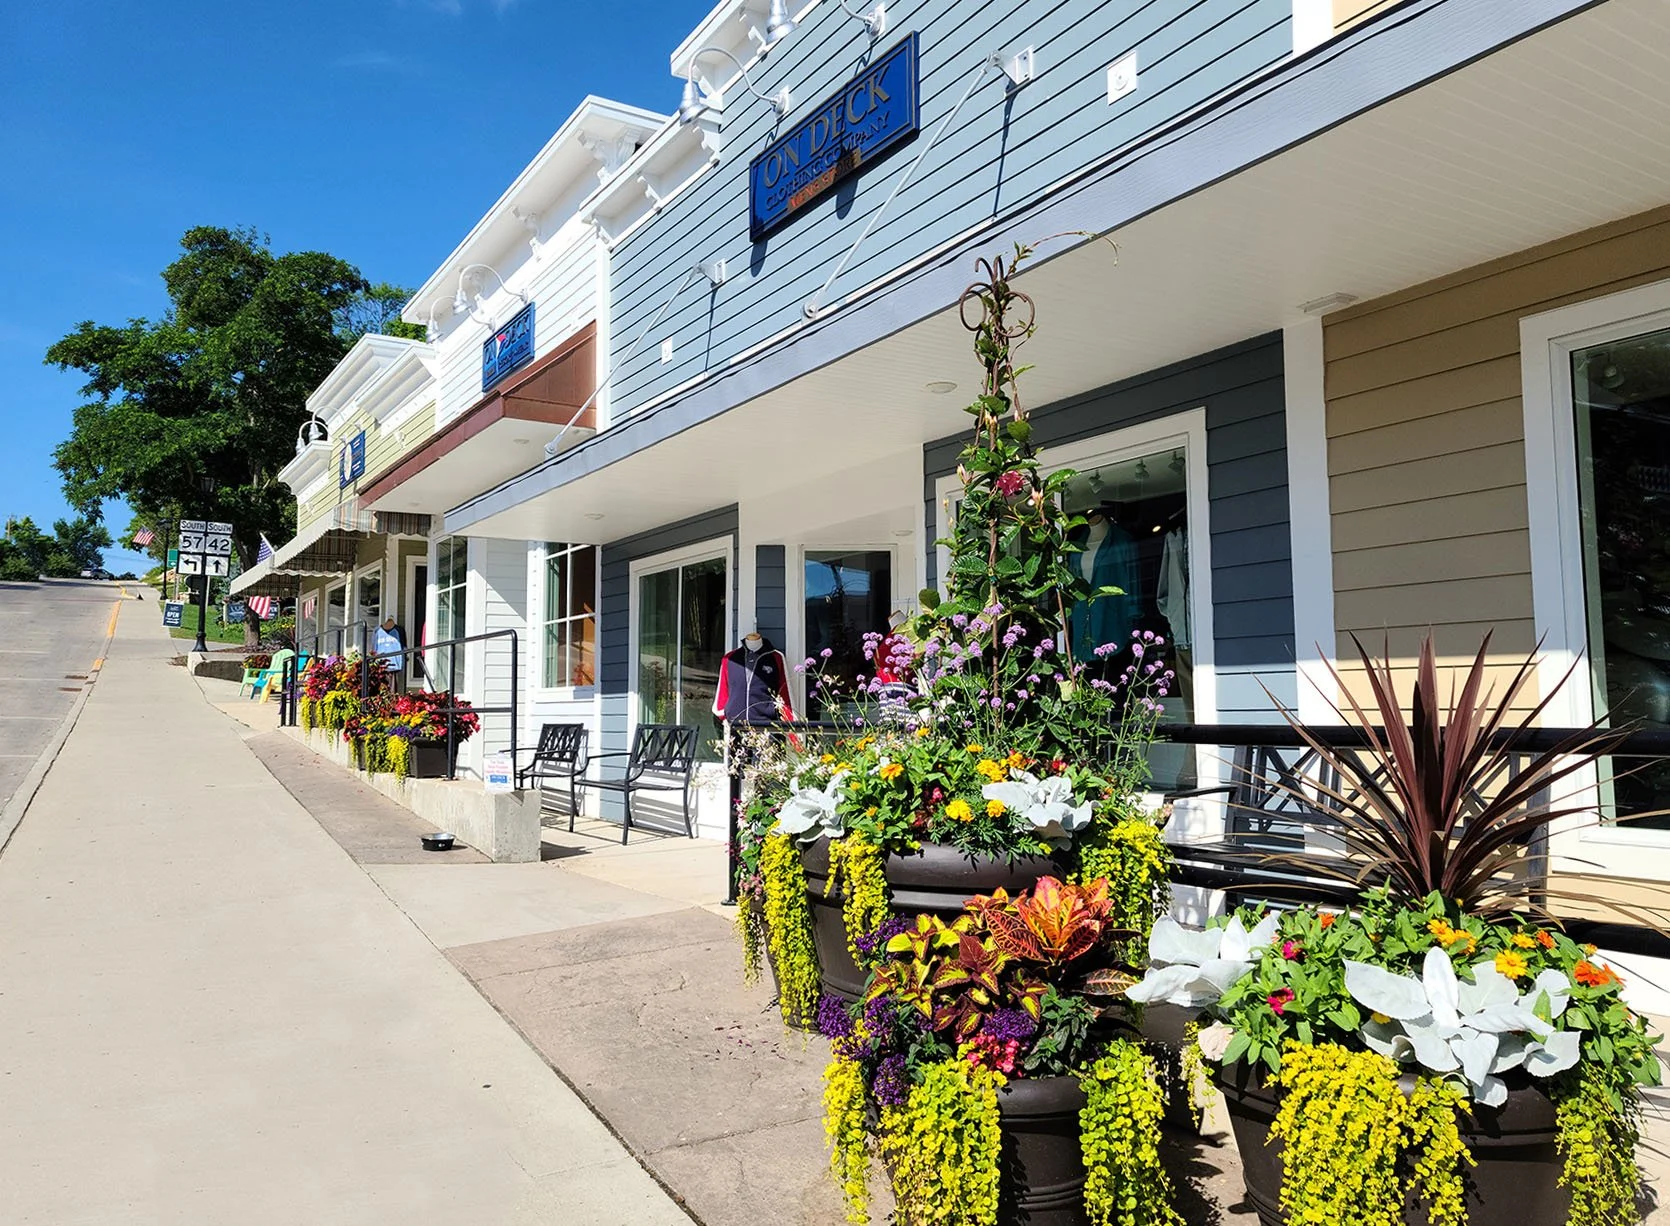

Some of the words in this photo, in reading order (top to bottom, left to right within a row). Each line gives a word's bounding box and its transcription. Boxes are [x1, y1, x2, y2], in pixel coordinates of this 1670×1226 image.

[765, 134, 801, 187] ON
[809, 64, 890, 157] DECK
[766, 160, 822, 211] CLOTHING
[823, 111, 890, 168] COMPANY
[181, 520, 205, 530] SOUTH
[208, 523, 232, 532] SOUTH
[182, 535, 203, 549] 57
[207, 538, 230, 552] 42
